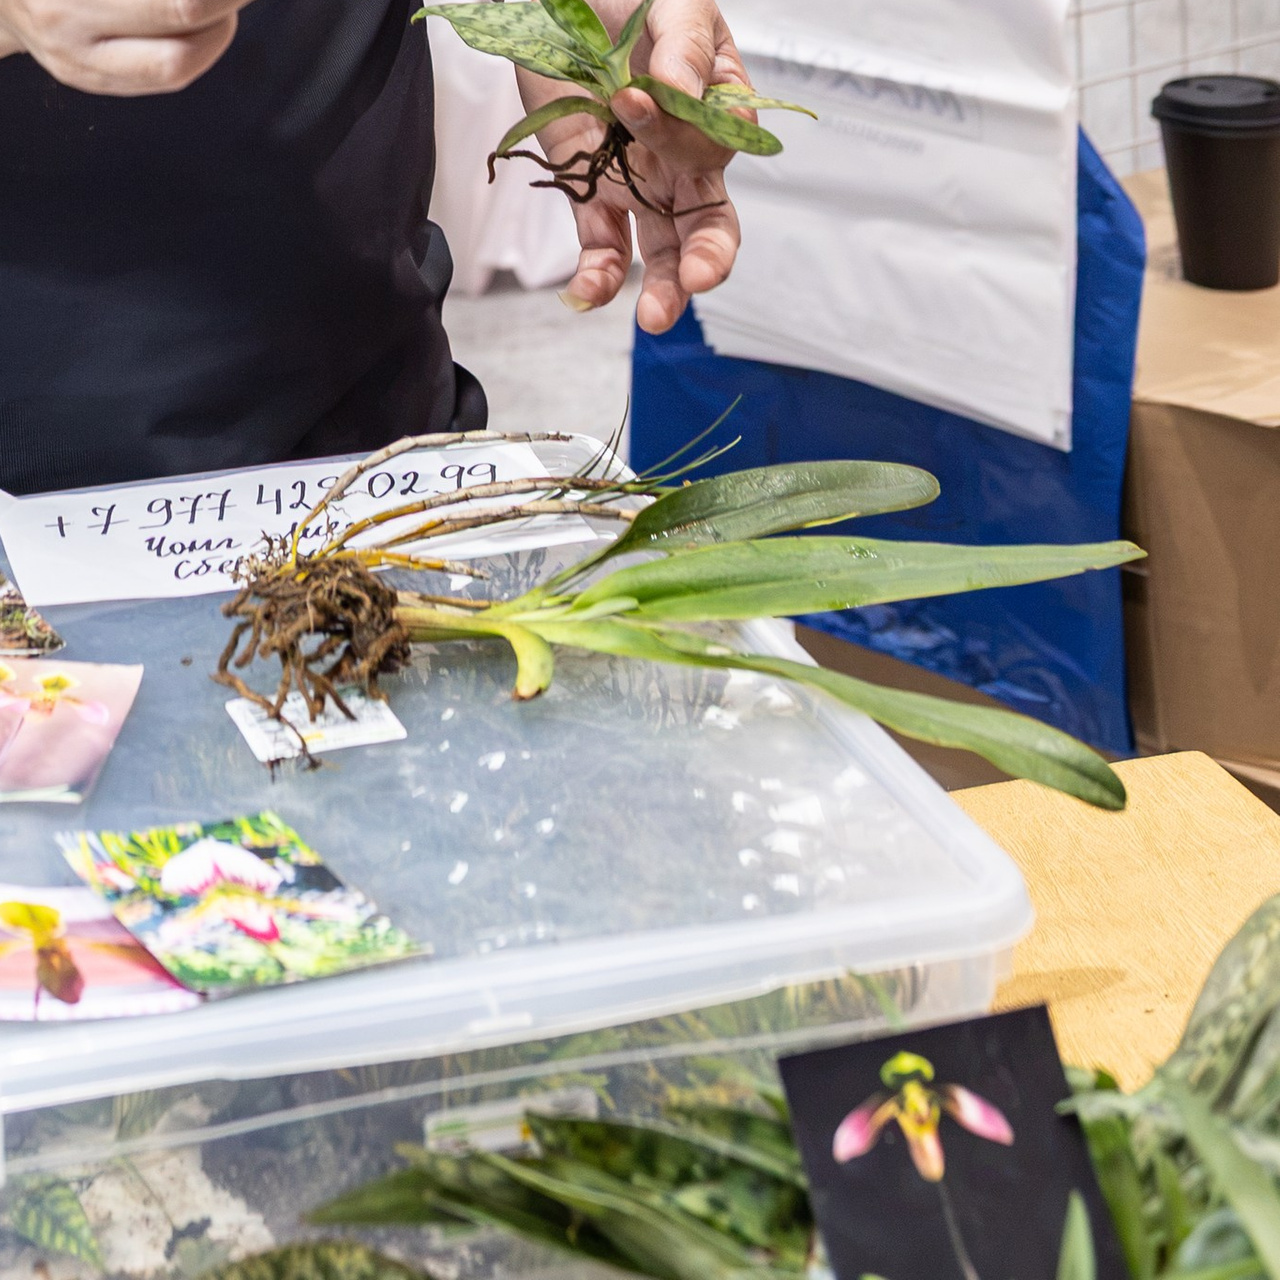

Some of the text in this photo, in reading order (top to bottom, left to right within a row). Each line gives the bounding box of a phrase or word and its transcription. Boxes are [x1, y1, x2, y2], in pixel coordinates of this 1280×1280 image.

[138, 488, 237, 529] 977
[367, 471, 428, 499] 02
[434, 462, 497, 494] 99
